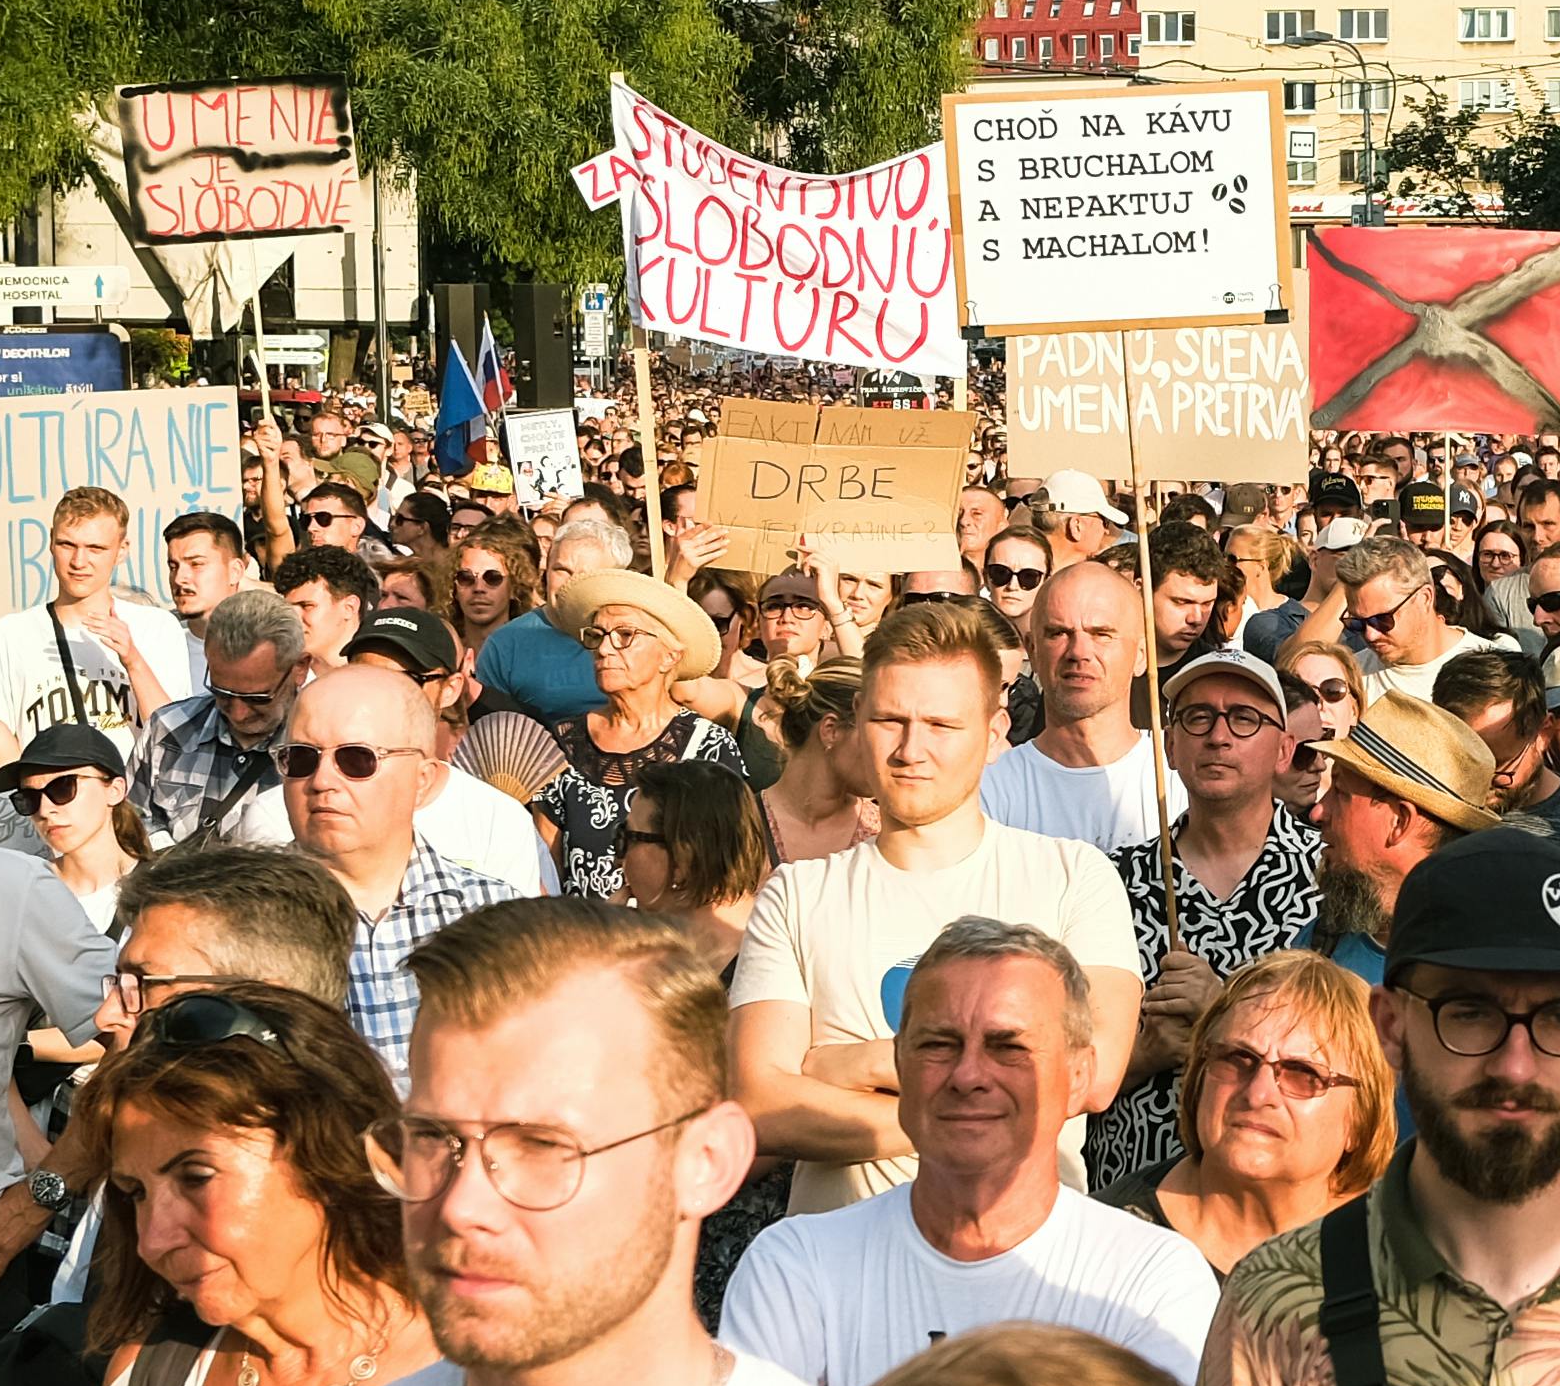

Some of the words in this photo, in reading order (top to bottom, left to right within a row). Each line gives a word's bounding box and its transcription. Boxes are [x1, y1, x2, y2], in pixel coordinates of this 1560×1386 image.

[143, 83, 339, 152] UMENIE
[973, 108, 1058, 142] CHOĎ
[1080, 114, 1126, 138] NA
[1146, 102, 1233, 135] KÁVU
[190, 155, 236, 188] JE
[578, 155, 640, 202] ZA
[978, 159, 996, 182] S
[1019, 150, 1215, 181] BRUCHALOM
[145, 166, 358, 236] SLOBODNÉ
[978, 199, 1001, 222] A
[1021, 191, 1194, 221] NEPAKTUJ
[635, 173, 952, 299] SLOBODNÚ
[982, 239, 1001, 262] S
[1022, 228, 1210, 261] MACHALOM!
[2, 290, 63, 301] HOSPITAL
[635, 246, 928, 364] KULTÚRU
[2, 347, 71, 360] DECATHLON
[10, 371, 23, 383] si
[167, 402, 233, 494] NIE
[725, 410, 810, 448] FAKT
[822, 413, 873, 445] NÁM
[749, 460, 897, 504] DRBE
[760, 518, 798, 547] TEJ
